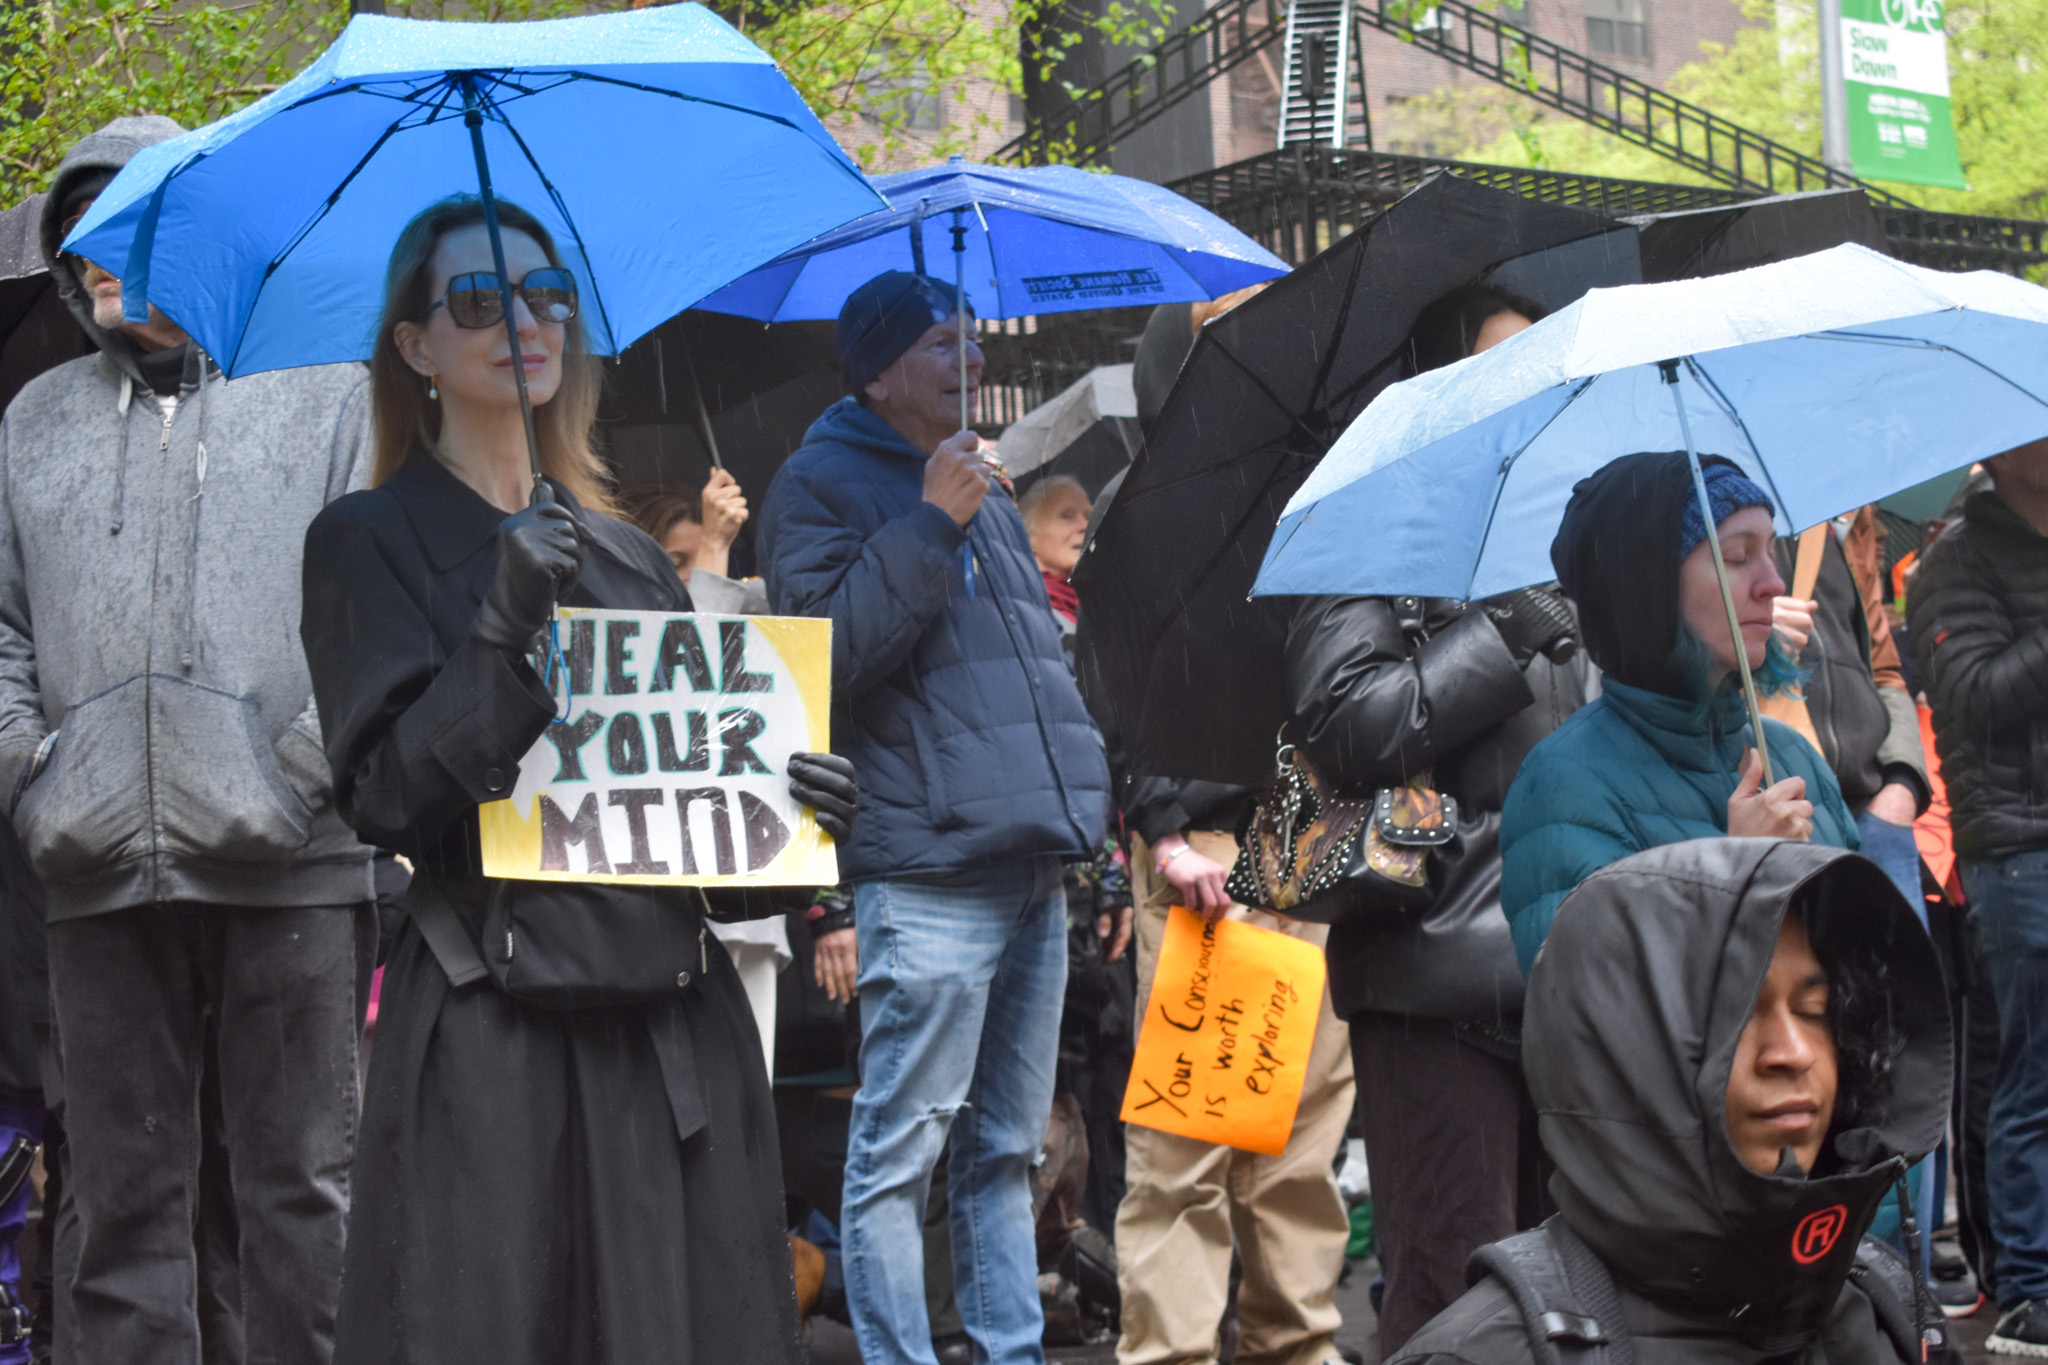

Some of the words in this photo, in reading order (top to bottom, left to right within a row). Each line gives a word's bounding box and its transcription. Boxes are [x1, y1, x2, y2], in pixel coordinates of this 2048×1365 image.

[1850, 27, 1888, 52] Slow
[1852, 53, 1897, 79] Down
[534, 617, 775, 696] HEAL
[543, 707, 776, 784] YOUR
[539, 786, 792, 876] MIND
[1212, 998, 1245, 1070] worth
[1245, 979, 1299, 1095] exploring
[1134, 1052, 1194, 1118] Your
[1200, 1095, 1227, 1118] is
